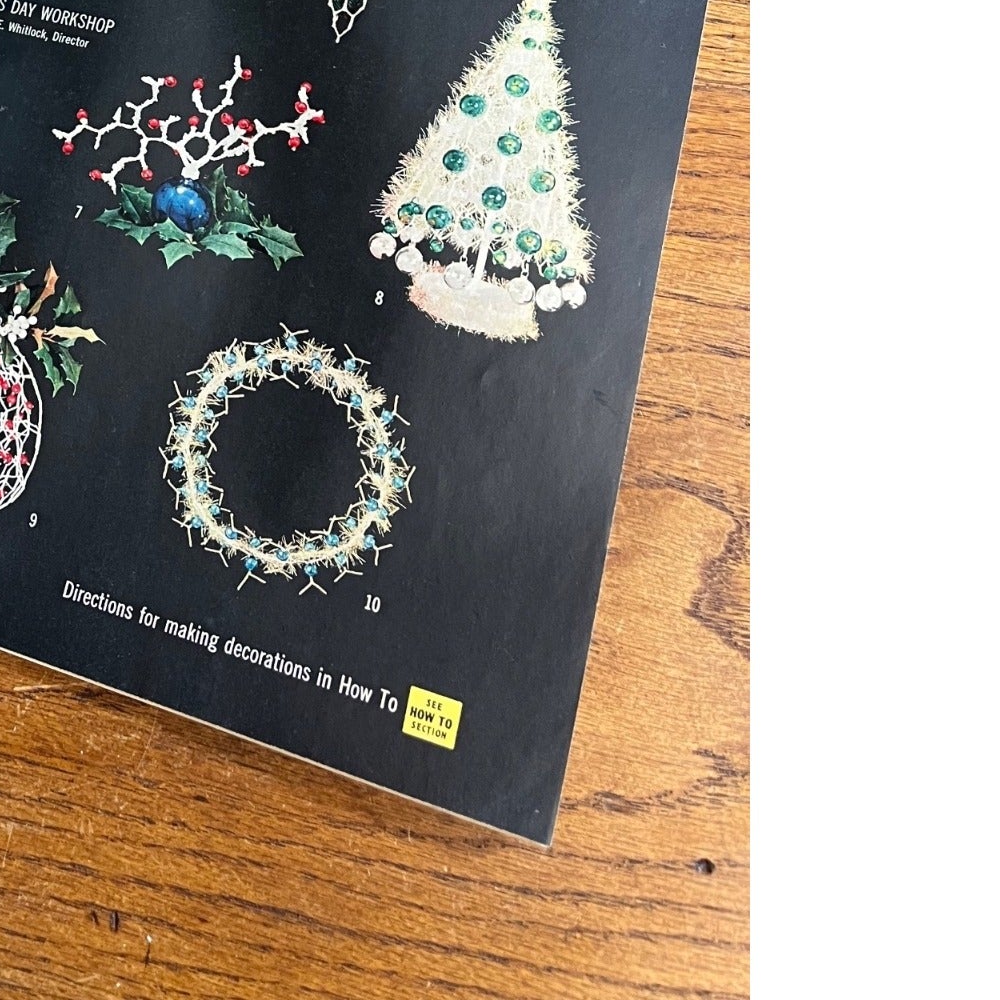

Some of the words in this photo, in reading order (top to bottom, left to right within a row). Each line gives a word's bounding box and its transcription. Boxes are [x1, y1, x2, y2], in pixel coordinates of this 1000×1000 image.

[10, 0, 37, 18] DAY
[41, 5, 116, 34] WORKSHOP
[8, 21, 49, 41] Whitlock,
[52, 31, 90, 49] Director
[74, 204, 83, 219] 7
[374, 290, 385, 306] 8
[28, 512, 38, 528] 9
[364, 594, 381, 613] 10
[62, 580, 134, 620] Directions
[138, 606, 160, 629] for
[164, 619, 220, 653] making
[224, 636, 312, 682] decorations
[316, 667, 333, 690] in
[339, 674, 373, 704] How
[379, 688, 398, 713] To
[426, 698, 443, 711] SEE
[409, 706, 435, 723] HOW
[439, 715, 453, 730] TO
[411, 721, 447, 740] SECTION
